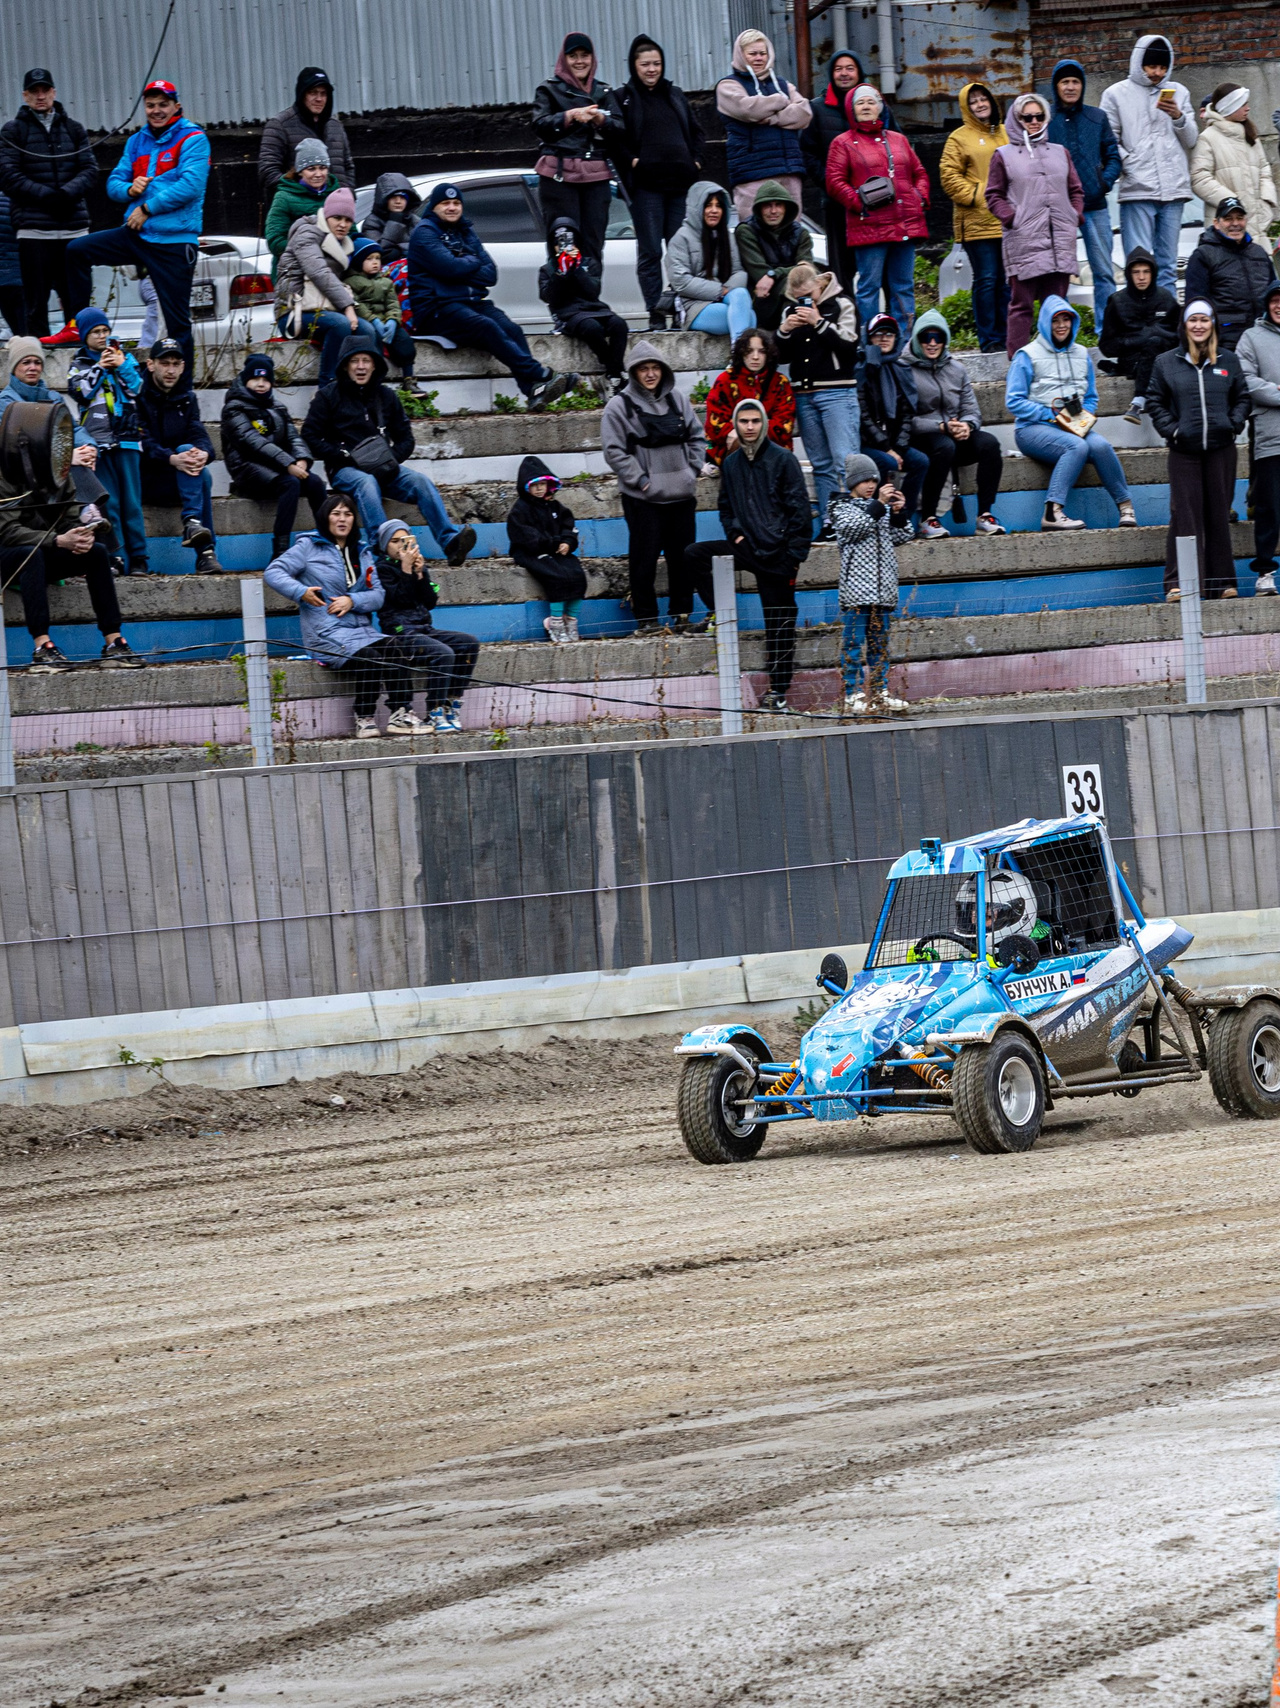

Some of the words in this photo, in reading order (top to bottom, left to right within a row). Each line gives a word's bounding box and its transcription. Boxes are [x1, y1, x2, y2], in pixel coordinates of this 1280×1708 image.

[1067, 770, 1101, 814] 33
[1004, 976, 1056, 1000] БУНЧУК
[1060, 975, 1071, 990] А.
